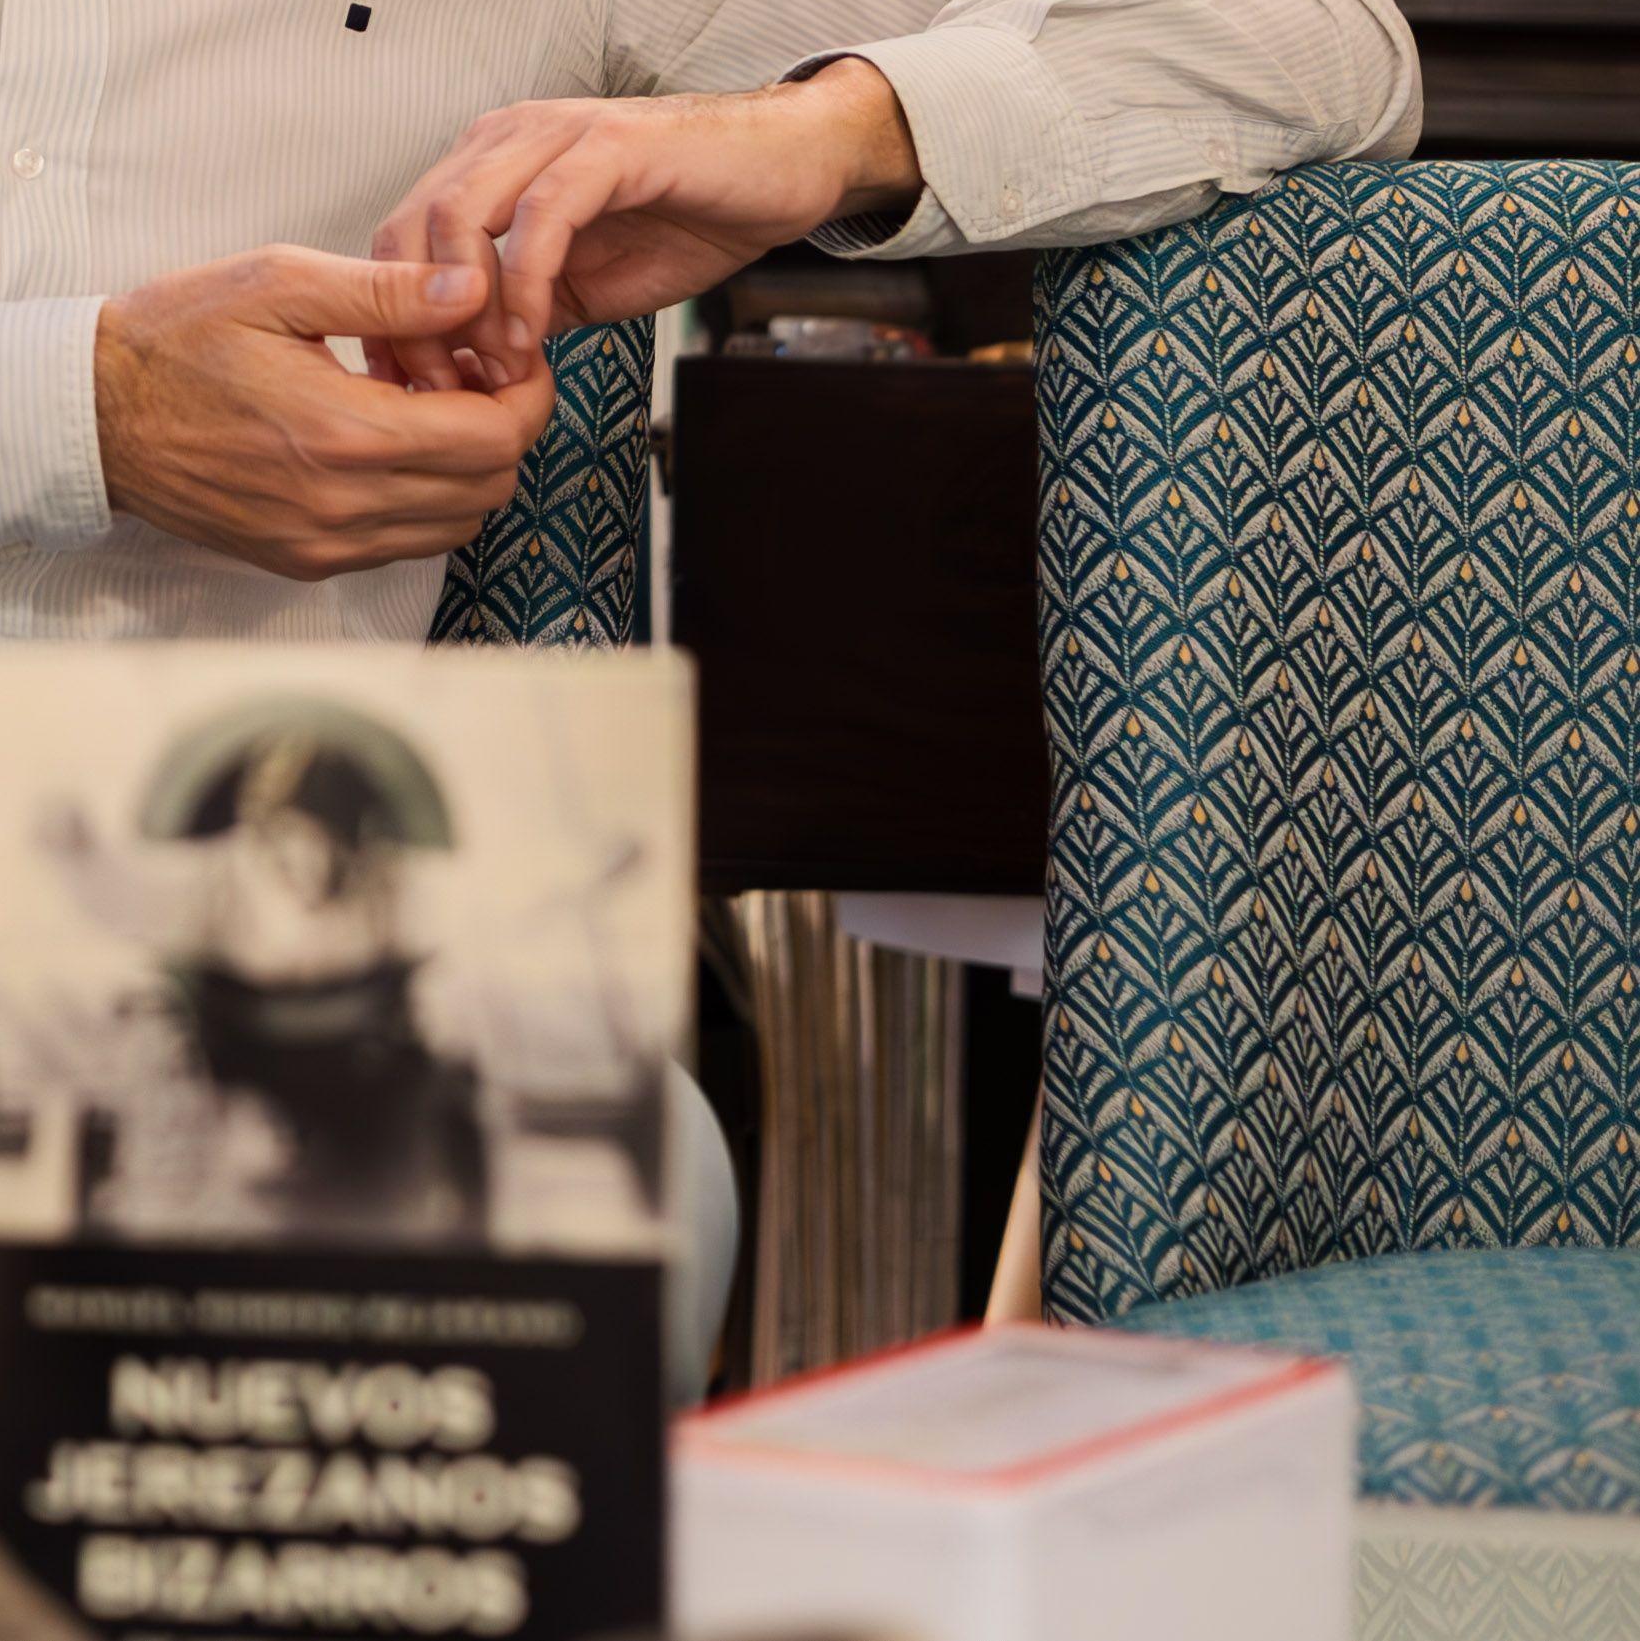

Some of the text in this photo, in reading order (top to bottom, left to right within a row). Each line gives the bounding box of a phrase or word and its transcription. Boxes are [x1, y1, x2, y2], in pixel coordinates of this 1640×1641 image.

[111, 1358, 493, 1450] NUEVOS
[26, 1438, 579, 1542] JEREZANOS
[78, 1532, 525, 1635] BIZARROS
